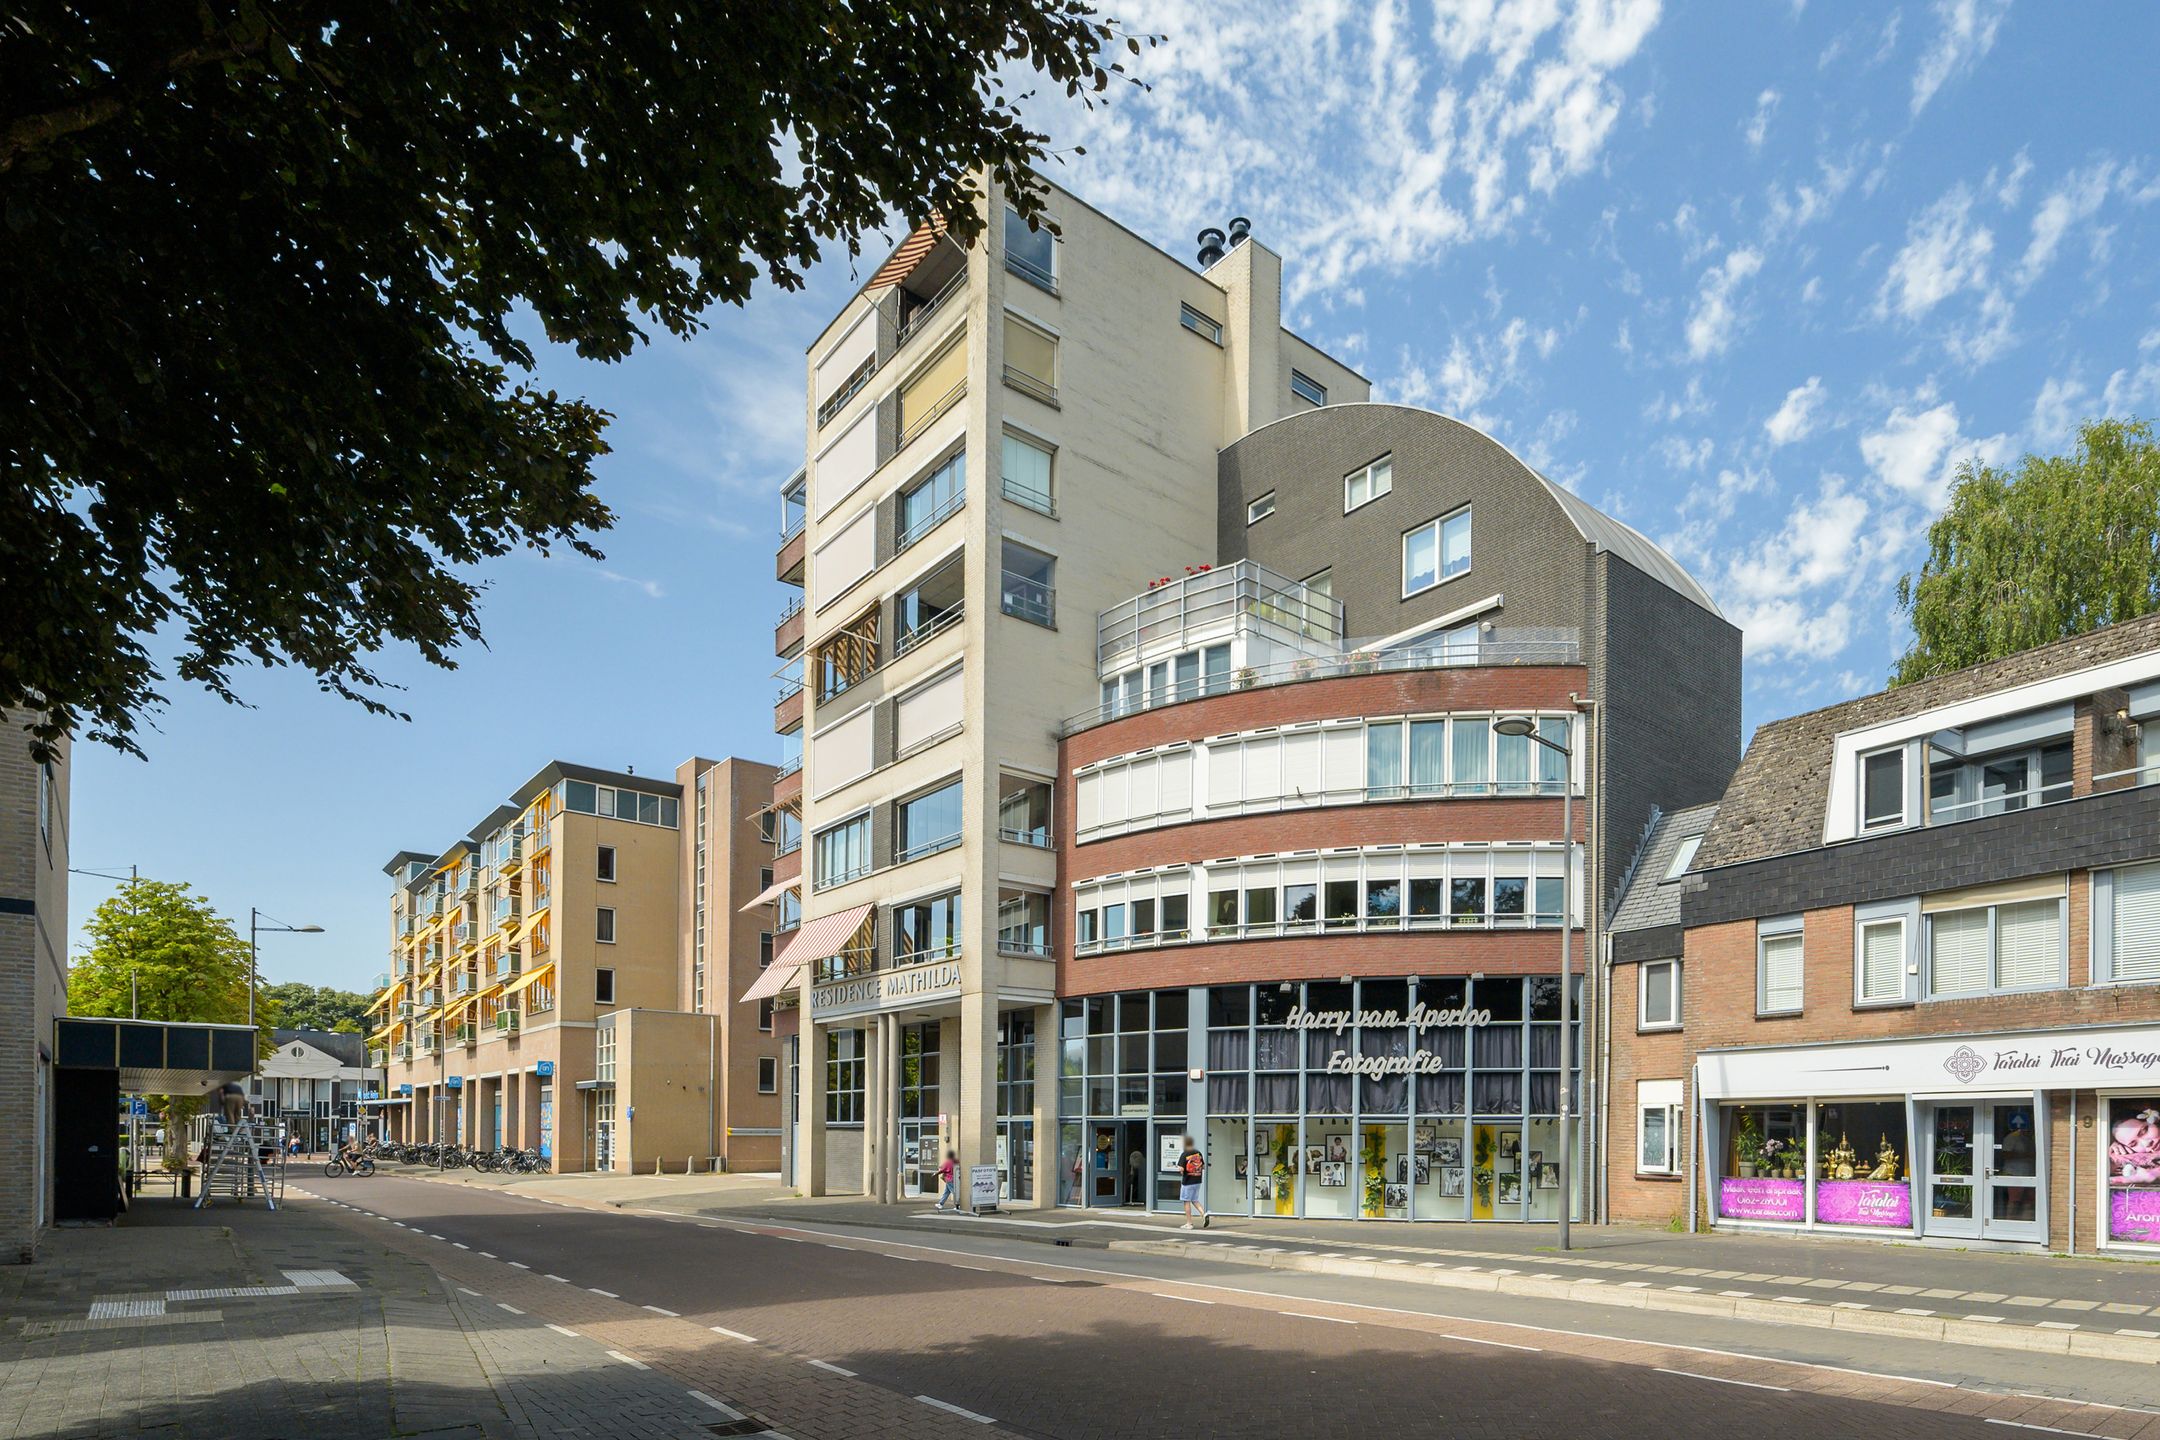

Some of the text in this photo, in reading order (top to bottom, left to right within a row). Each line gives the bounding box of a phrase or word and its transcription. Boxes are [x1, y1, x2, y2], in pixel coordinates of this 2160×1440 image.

[812, 964, 962, 1009] RESIDENCE MATHILDA
[1286, 1002, 1491, 1036] Harry van Aperloo
[1326, 1049, 1443, 1082] Fotografie
[1993, 1050, 2041, 1071] Taralai
[2050, 1047, 2081, 1069] Thai
[2083, 1114, 2093, 1129] 9
[1857, 1189, 1900, 1208] Taralai
